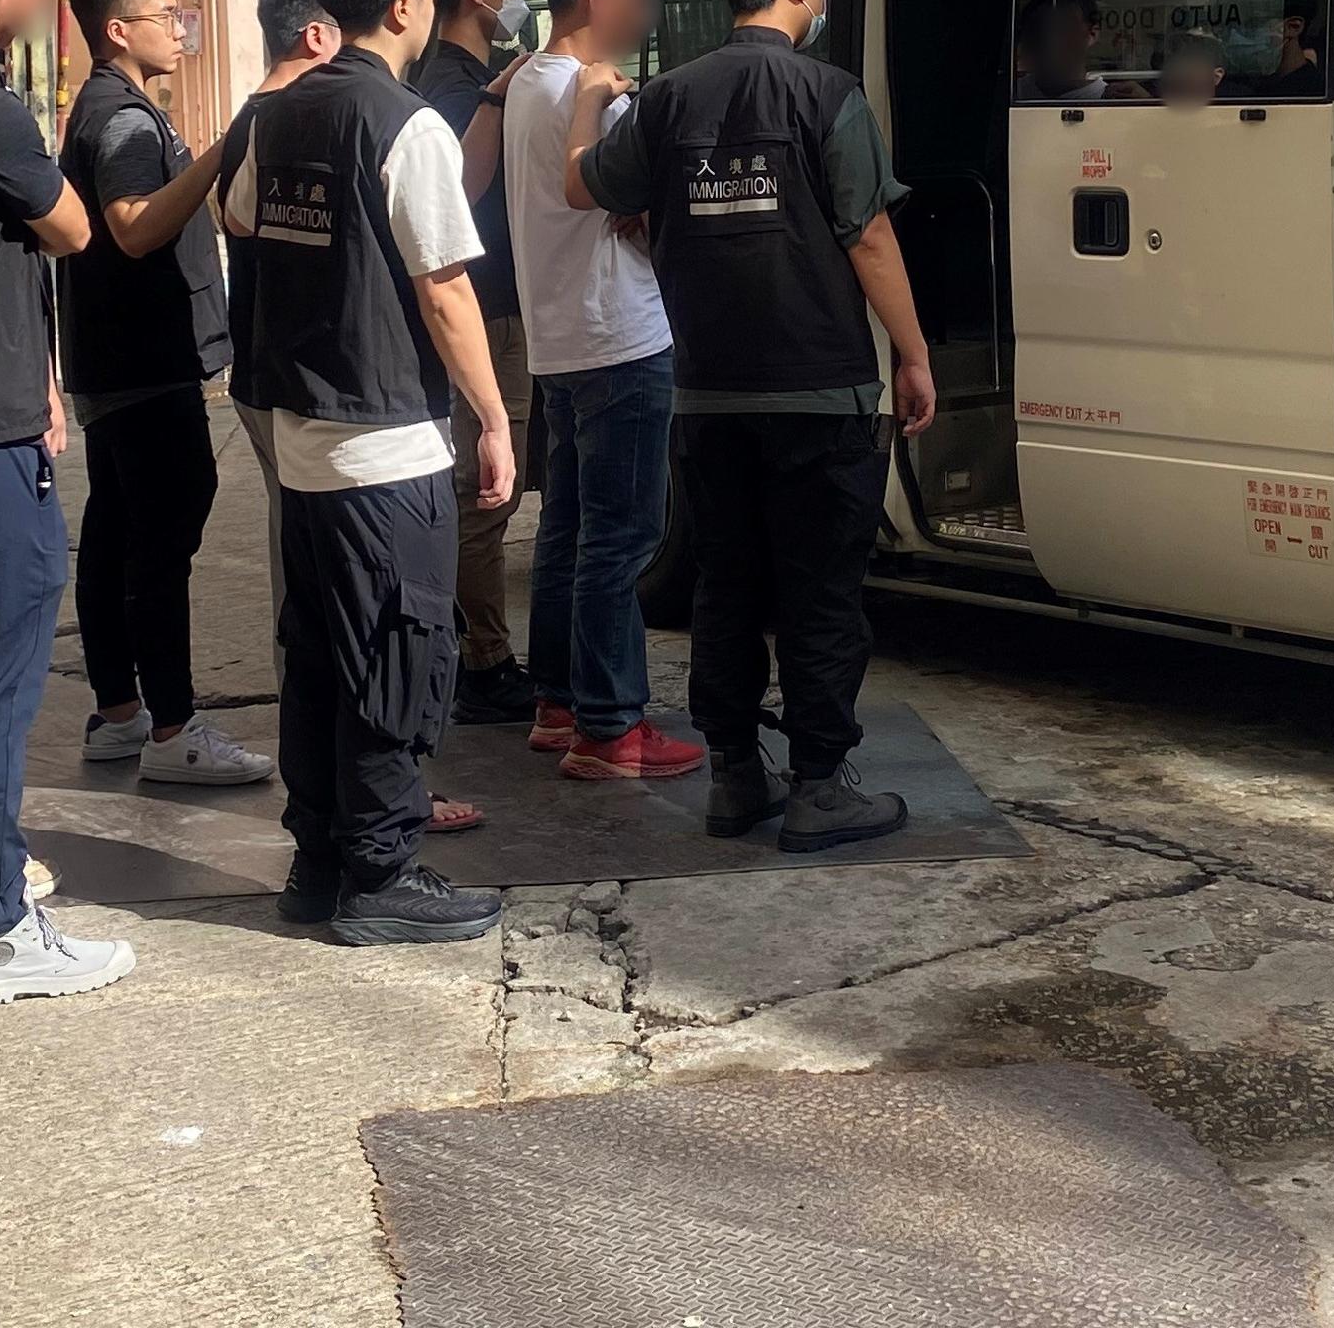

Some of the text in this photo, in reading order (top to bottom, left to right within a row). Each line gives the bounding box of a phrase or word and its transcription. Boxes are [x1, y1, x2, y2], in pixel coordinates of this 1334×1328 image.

[688, 176, 778, 199] IMMIGRATION
[1019, 401, 1122, 425] EMERGENCY EXIT 太平門
[1254, 518, 1282, 536] OPEN
